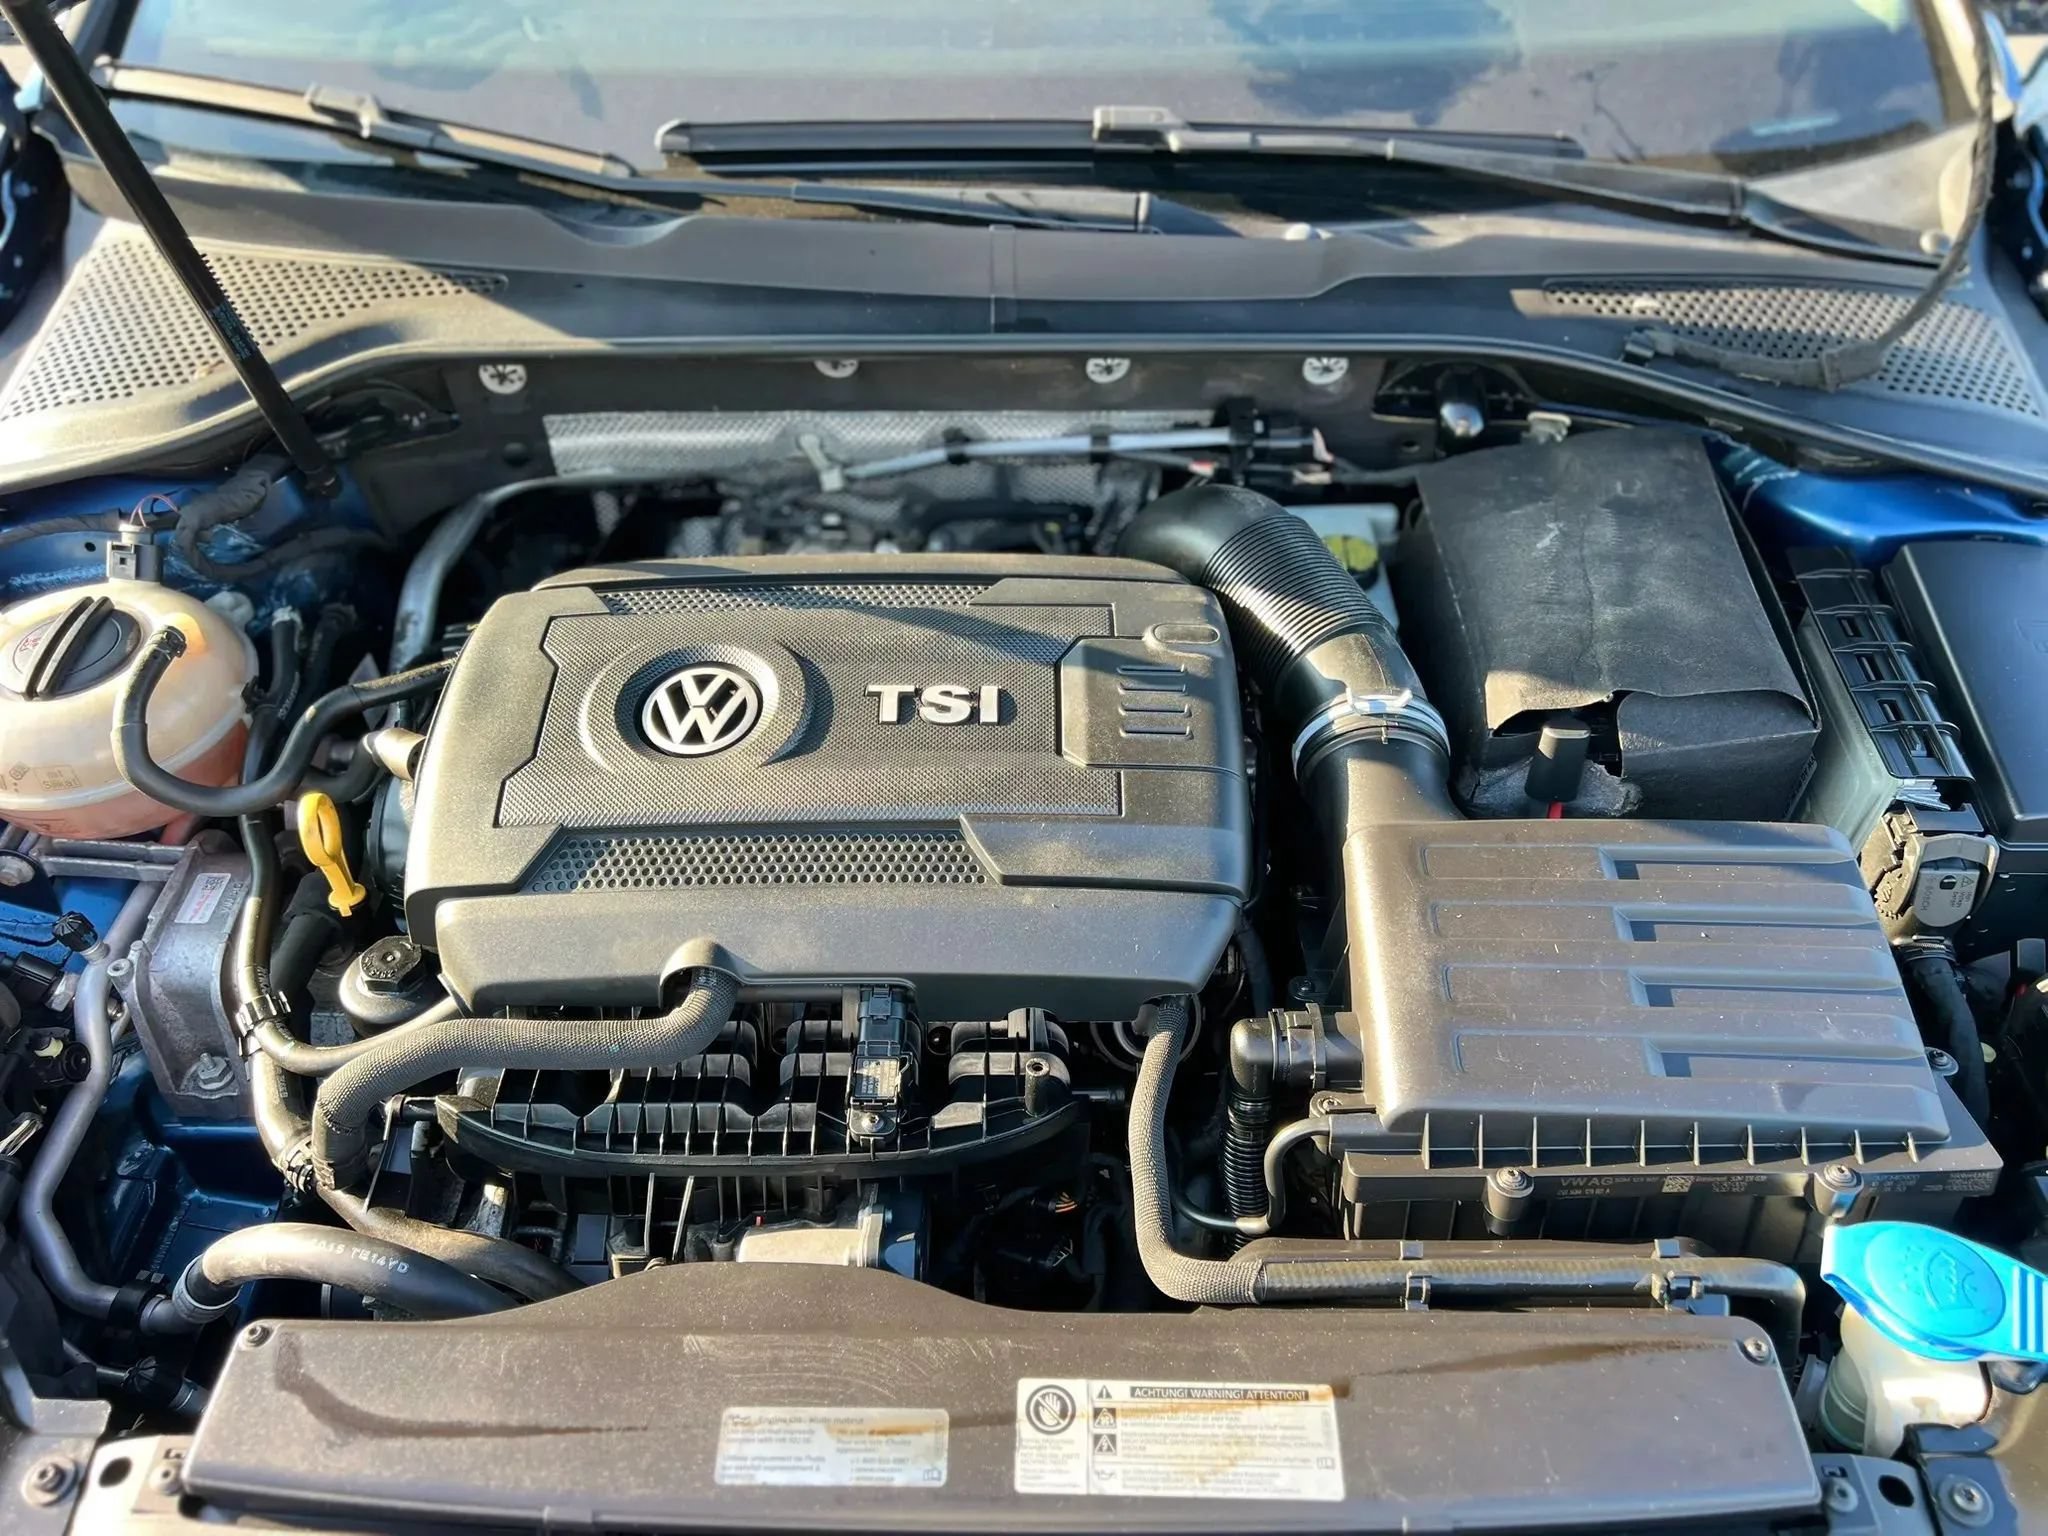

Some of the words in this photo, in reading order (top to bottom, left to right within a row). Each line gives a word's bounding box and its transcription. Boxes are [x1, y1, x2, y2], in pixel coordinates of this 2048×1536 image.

[644, 668, 757, 754] VW
[865, 685, 1001, 726] TSI
[1134, 1387, 1188, 1398] ACHTUNG!
[1190, 1388, 1243, 1399] WARNING!
[1247, 1389, 1306, 1400] ATTENTION!
